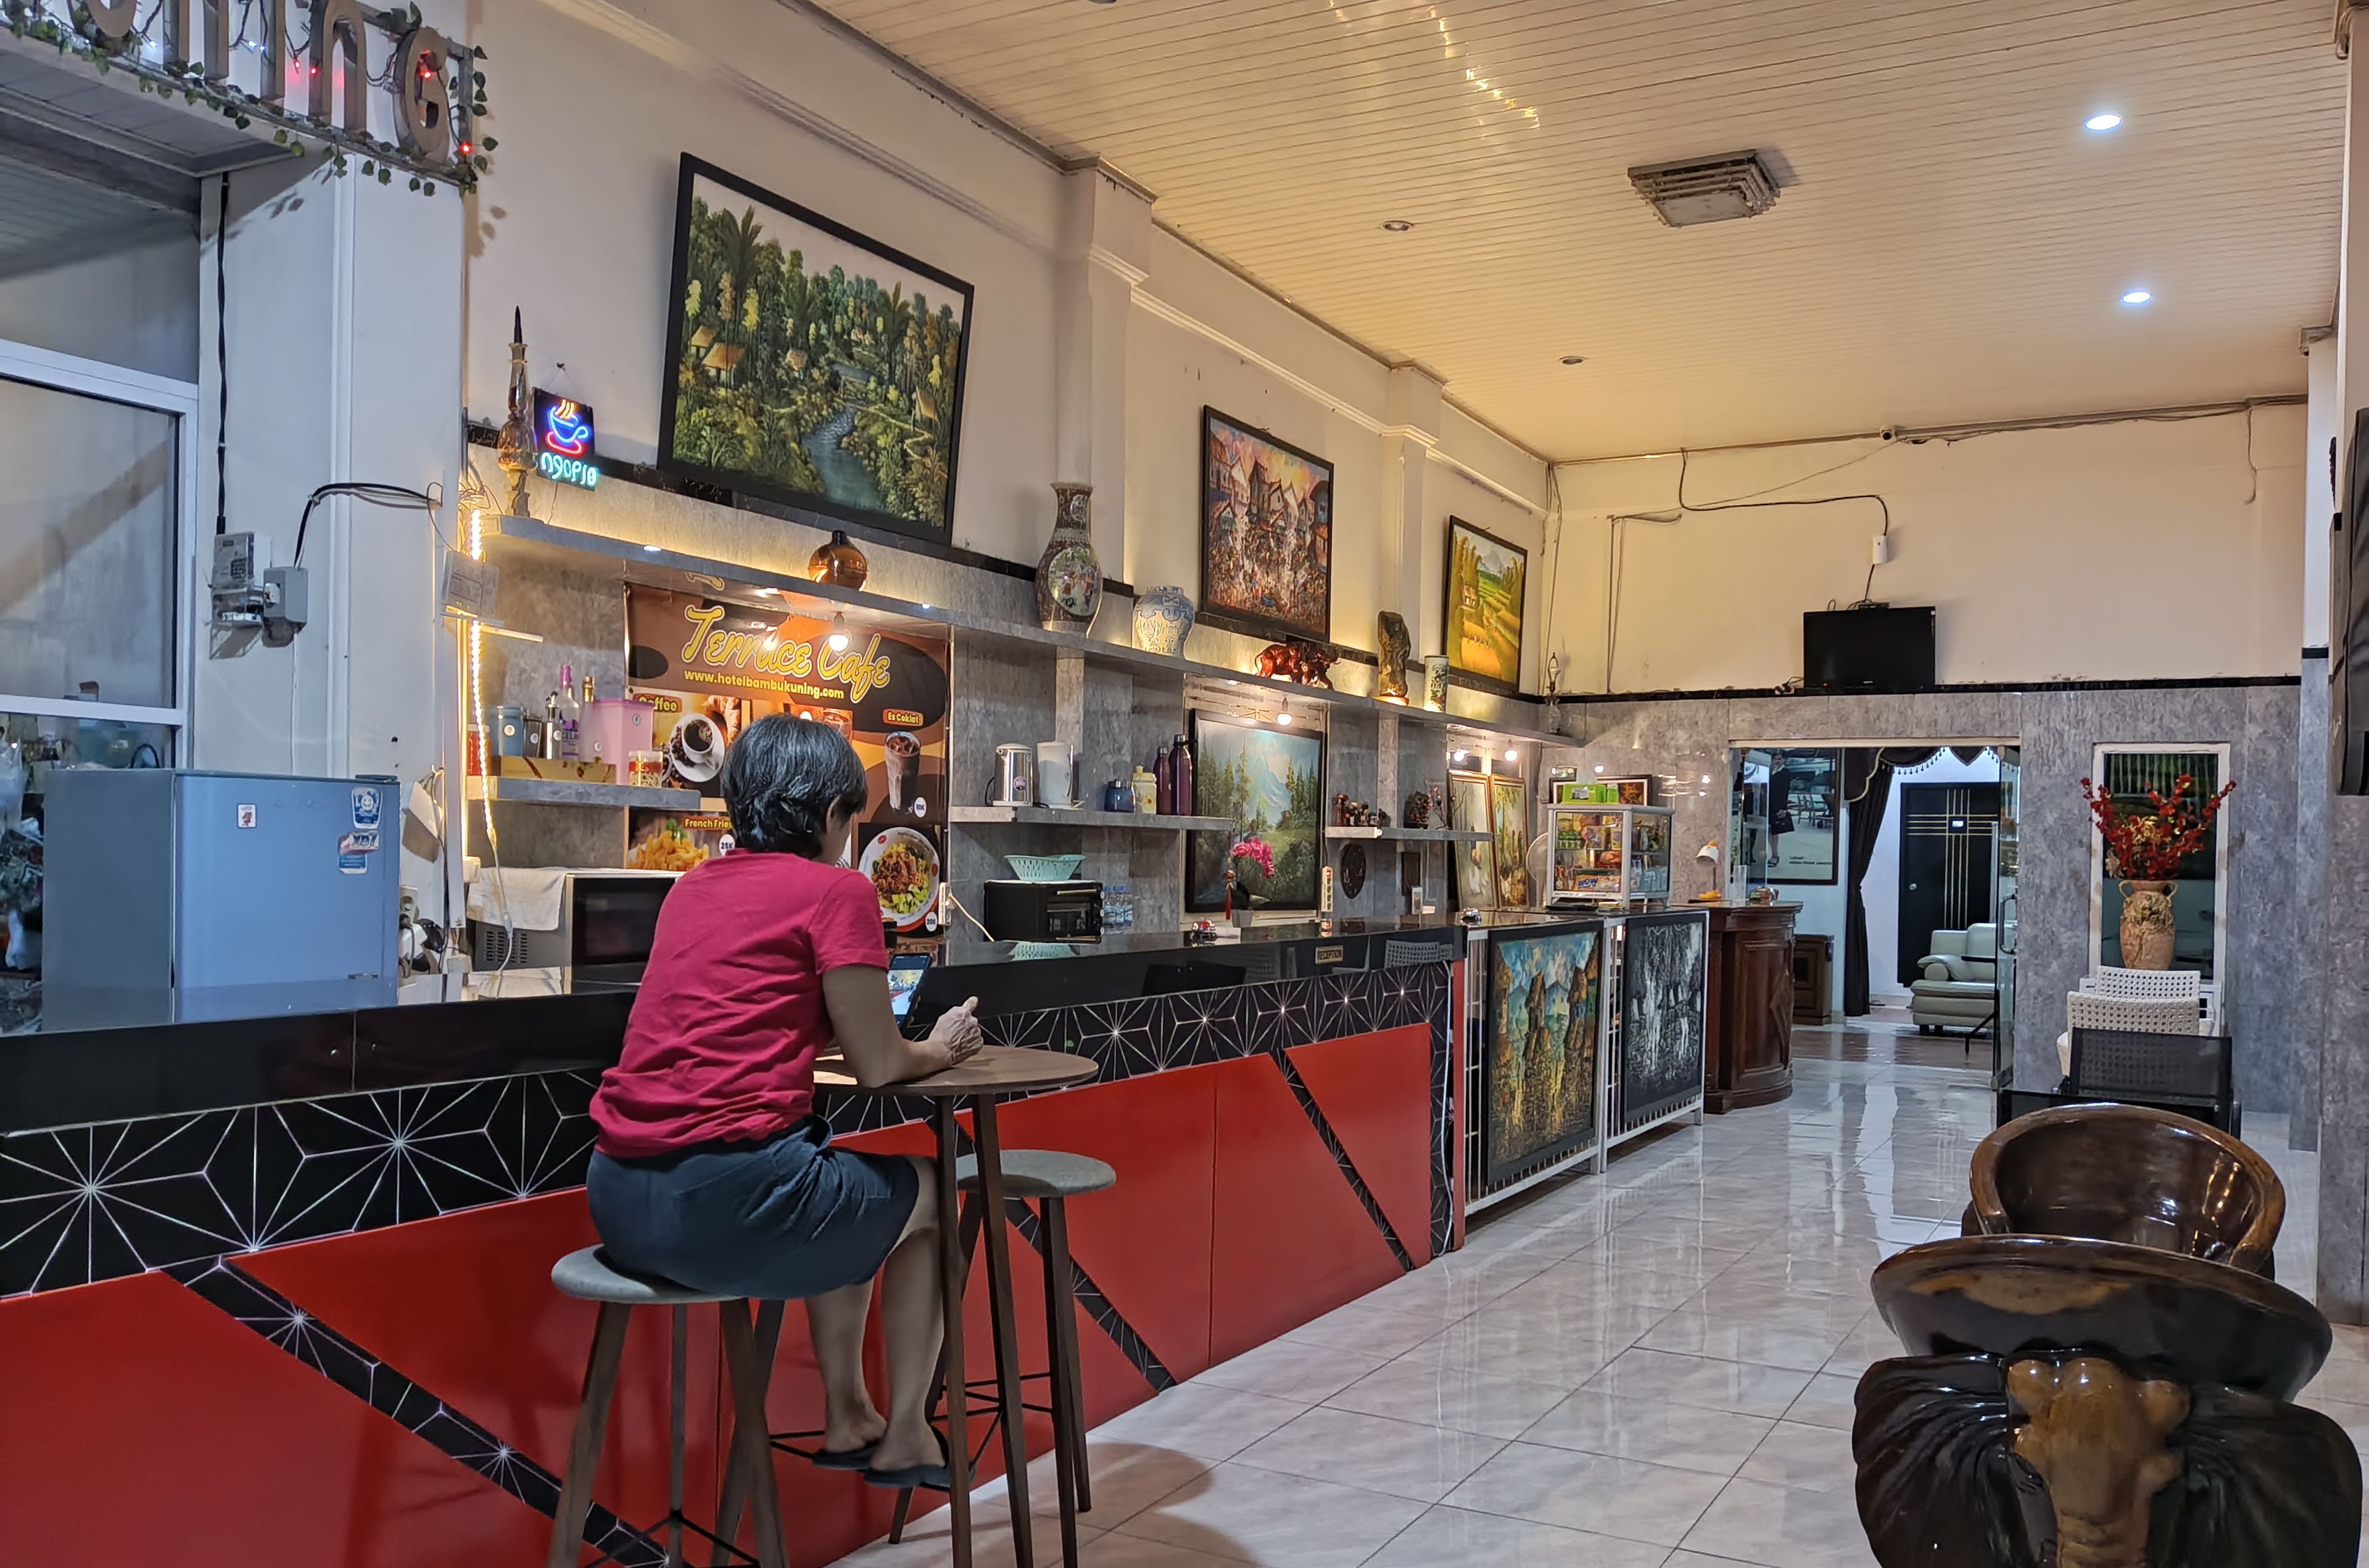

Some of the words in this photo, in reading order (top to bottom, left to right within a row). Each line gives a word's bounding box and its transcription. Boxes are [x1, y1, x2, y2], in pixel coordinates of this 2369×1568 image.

[682, 605, 812, 678] Terrace
[817, 633, 890, 703] Cafe
[684, 670, 845, 699] www.hotelbambukuning.com
[888, 712, 895, 721] Es
[896, 713, 919, 724] Coklat
[685, 819, 713, 828] French
